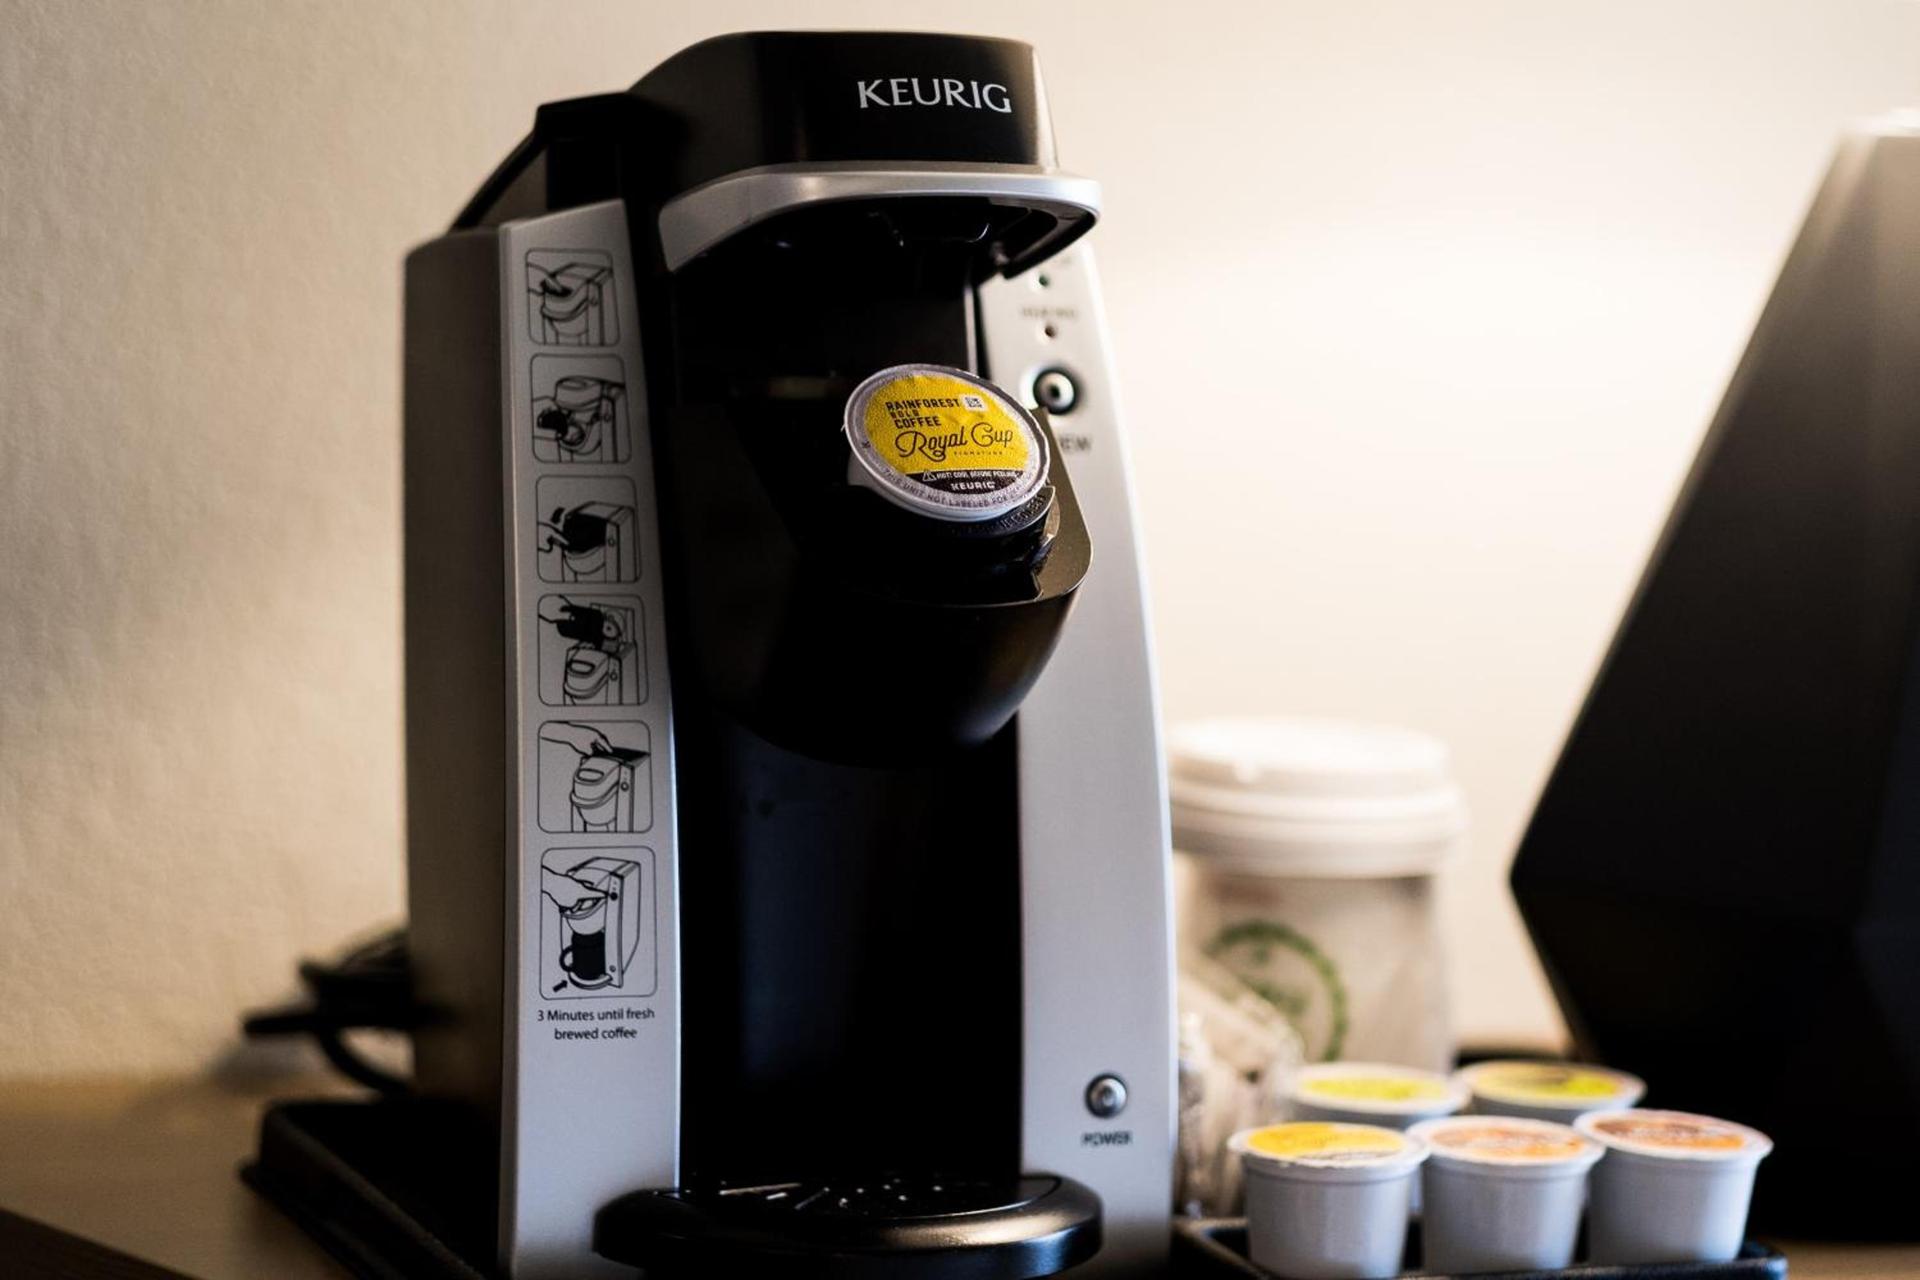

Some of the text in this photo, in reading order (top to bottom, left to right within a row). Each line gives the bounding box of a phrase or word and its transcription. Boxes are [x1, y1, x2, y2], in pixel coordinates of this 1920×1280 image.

[857, 78, 1012, 113] KEURIG
[885, 398, 960, 411] RAINFOREST
[889, 409, 920, 419] BOLD
[894, 416, 942, 429] COFFEE
[895, 422, 1013, 462] Royal Cup
[903, 481, 924, 497] UNIT
[927, 494, 946, 504] NOT
[951, 481, 996, 491] KEURIG
[537, 1007, 655, 1021] 3 Minutes until fresh
[554, 1026, 638, 1040] brewed coffee
[1082, 1130, 1133, 1146] POWER
